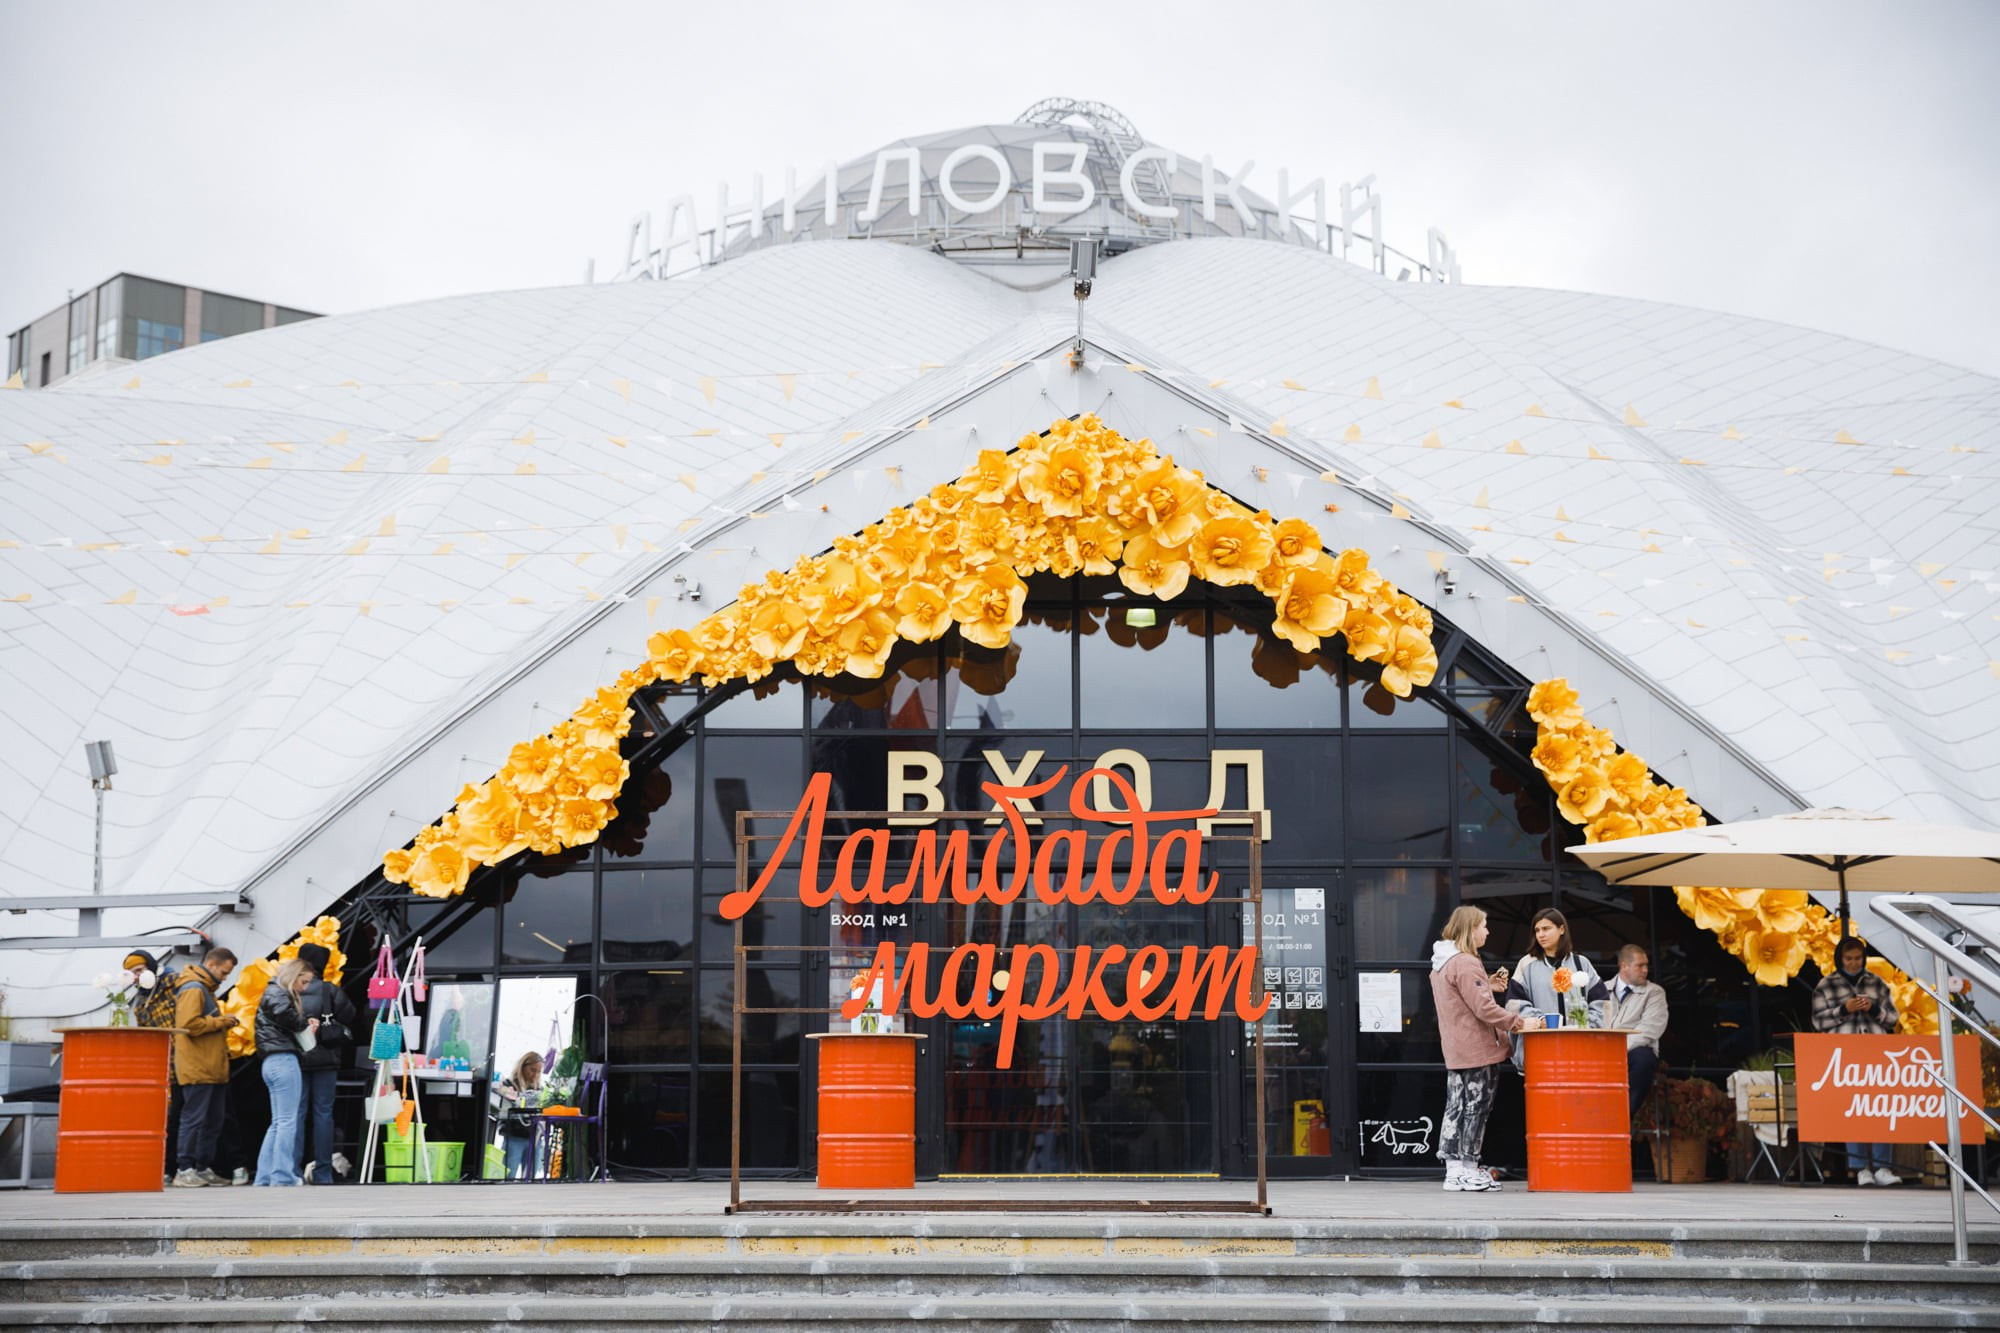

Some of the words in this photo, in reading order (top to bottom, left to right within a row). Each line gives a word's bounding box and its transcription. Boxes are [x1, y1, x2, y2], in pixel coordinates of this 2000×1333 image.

[612, 141, 1382, 282] ДАНИЛОВСКИЙ
[719, 764, 1219, 920] Ламбада
[887, 748, 1272, 841] ВХОД
[831, 914, 875, 928] ВХОД
[882, 913, 908, 927] №1
[1294, 912, 1320, 926] №1
[841, 941, 1272, 1069] маркет
